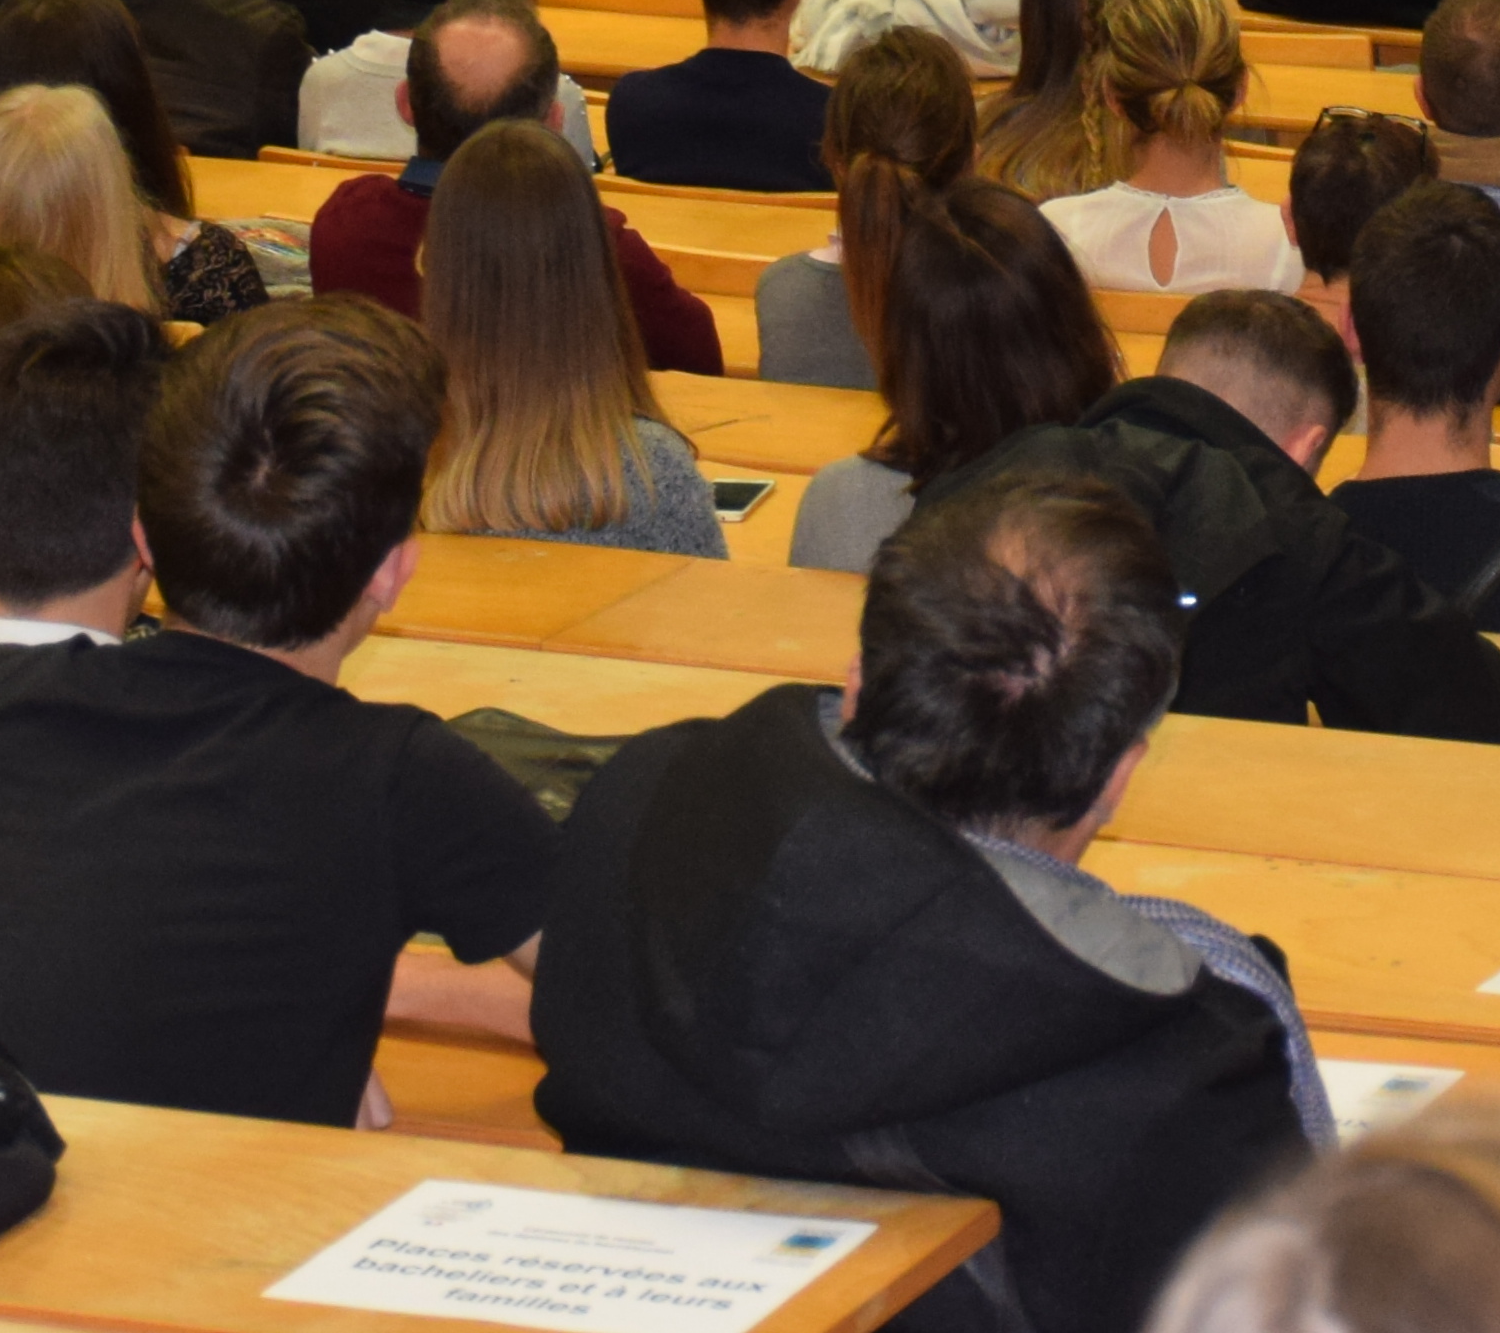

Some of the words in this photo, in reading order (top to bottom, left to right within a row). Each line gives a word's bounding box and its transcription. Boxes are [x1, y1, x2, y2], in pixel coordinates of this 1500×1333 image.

[352, 1255, 548, 1290] bacheliers
[557, 1280, 600, 1297] et
[603, 1282, 628, 1300] à
[636, 1286, 735, 1312] leurs
[367, 1237, 492, 1264] Places
[503, 1250, 688, 1285] réservées
[696, 1276, 770, 1294] aux
[443, 1286, 592, 1315] familles
